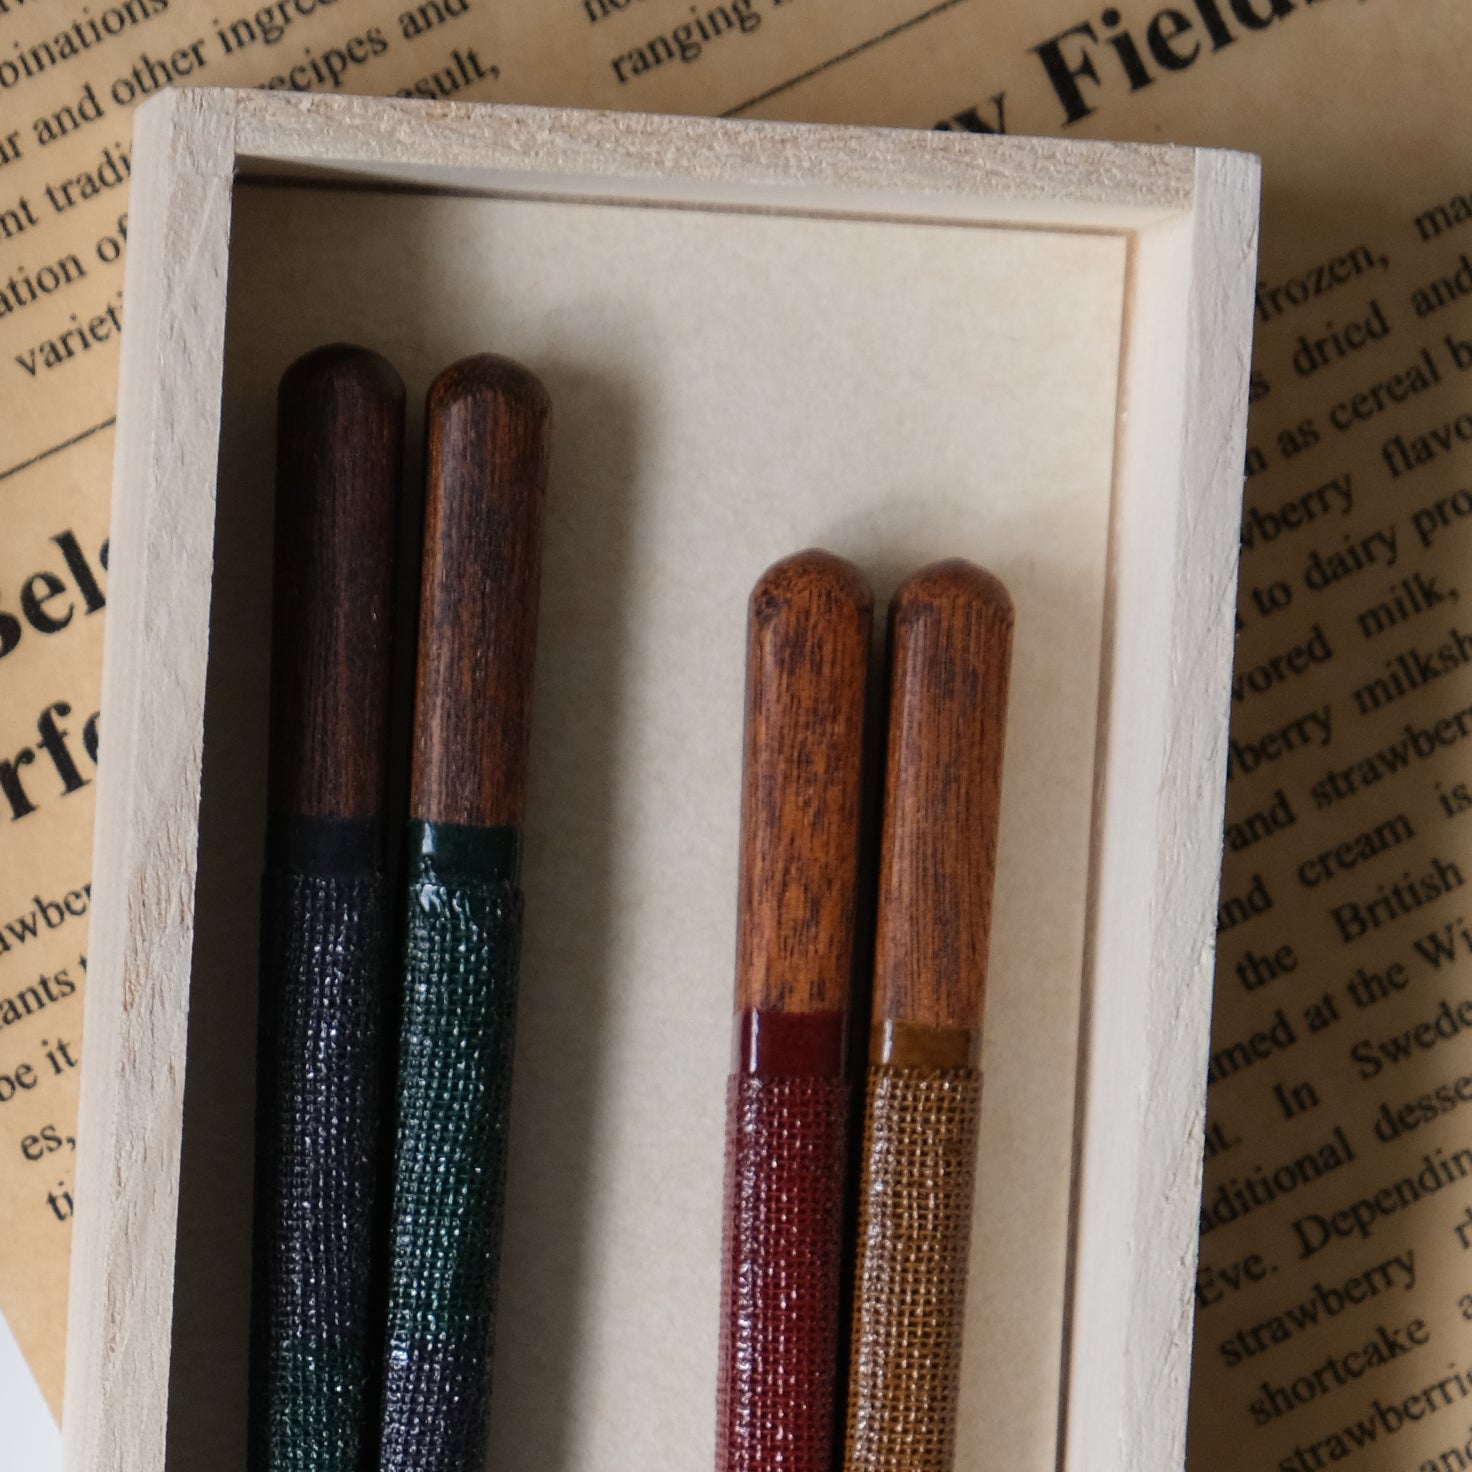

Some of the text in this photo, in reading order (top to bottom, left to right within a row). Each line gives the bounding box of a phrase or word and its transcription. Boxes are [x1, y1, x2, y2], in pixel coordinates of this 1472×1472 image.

[32, 81, 105, 146] and
[110, 37, 207, 106] other
[212, 0, 336, 54] ingre
[611, 0, 761, 84] ranging
[44, 140, 132, 214] tradi
[397, 0, 470, 41] and
[1255, 190, 1472, 322] frozen, ma
[1293, 299, 1390, 377] dried
[1411, 254, 1472, 318] and
[1278, 419, 1319, 458] as
[1330, 348, 1441, 430] cereal
[1251, 582, 1292, 618] to
[1305, 522, 1397, 590] dairy
[1224, 704, 1472, 851] and strawber
[1227, 704, 1332, 780] berry
[1217, 781, 1472, 934] nd cream is
[1236, 857, 1464, 991] the British
[1303, 993, 1341, 1033] at
[1347, 963, 1409, 1008] the
[41, 1036, 77, 1076] it
[1274, 1082, 1320, 1119] In
[1195, 1254, 1278, 1308] Eve.
[1219, 1249, 1416, 1367] strawberry
[1248, 1318, 1430, 1426] shortcake
